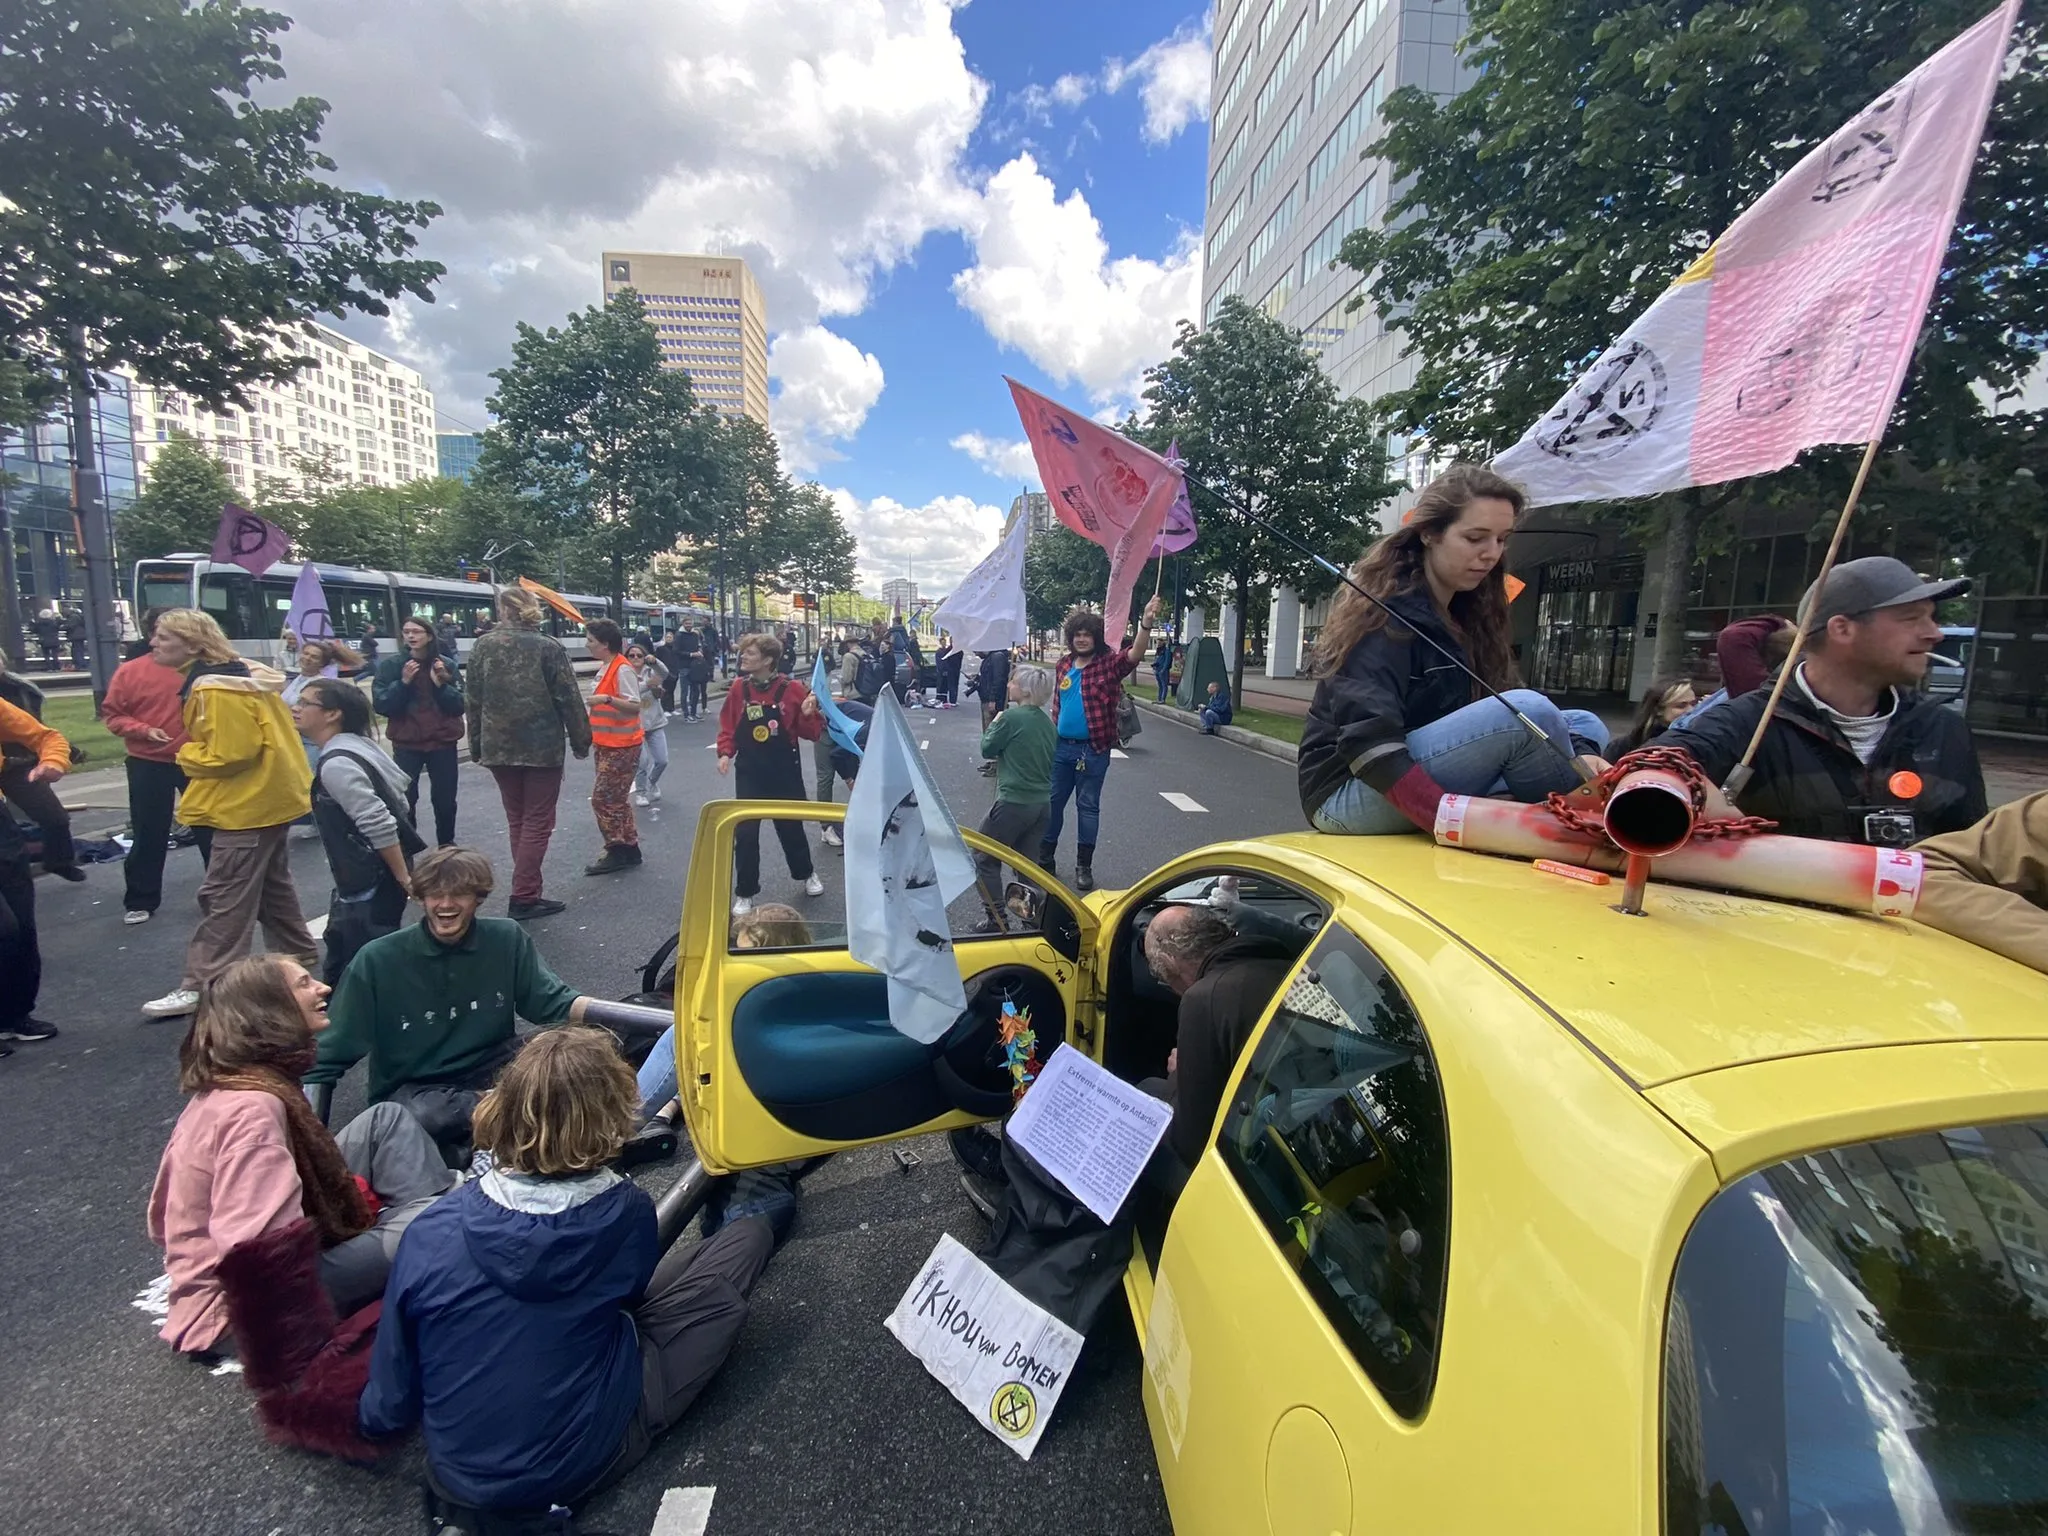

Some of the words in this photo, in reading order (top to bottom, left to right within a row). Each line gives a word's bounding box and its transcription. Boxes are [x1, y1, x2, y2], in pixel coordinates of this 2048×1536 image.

[1549, 560, 1595, 579] WEENA
[1067, 1066, 1096, 1090] Extreme
[1096, 1084, 1121, 1106] warmte
[1120, 1101, 1131, 1112] op
[978, 1334, 1001, 1357] VAN
[1003, 1339, 1063, 1390] BOMEN
